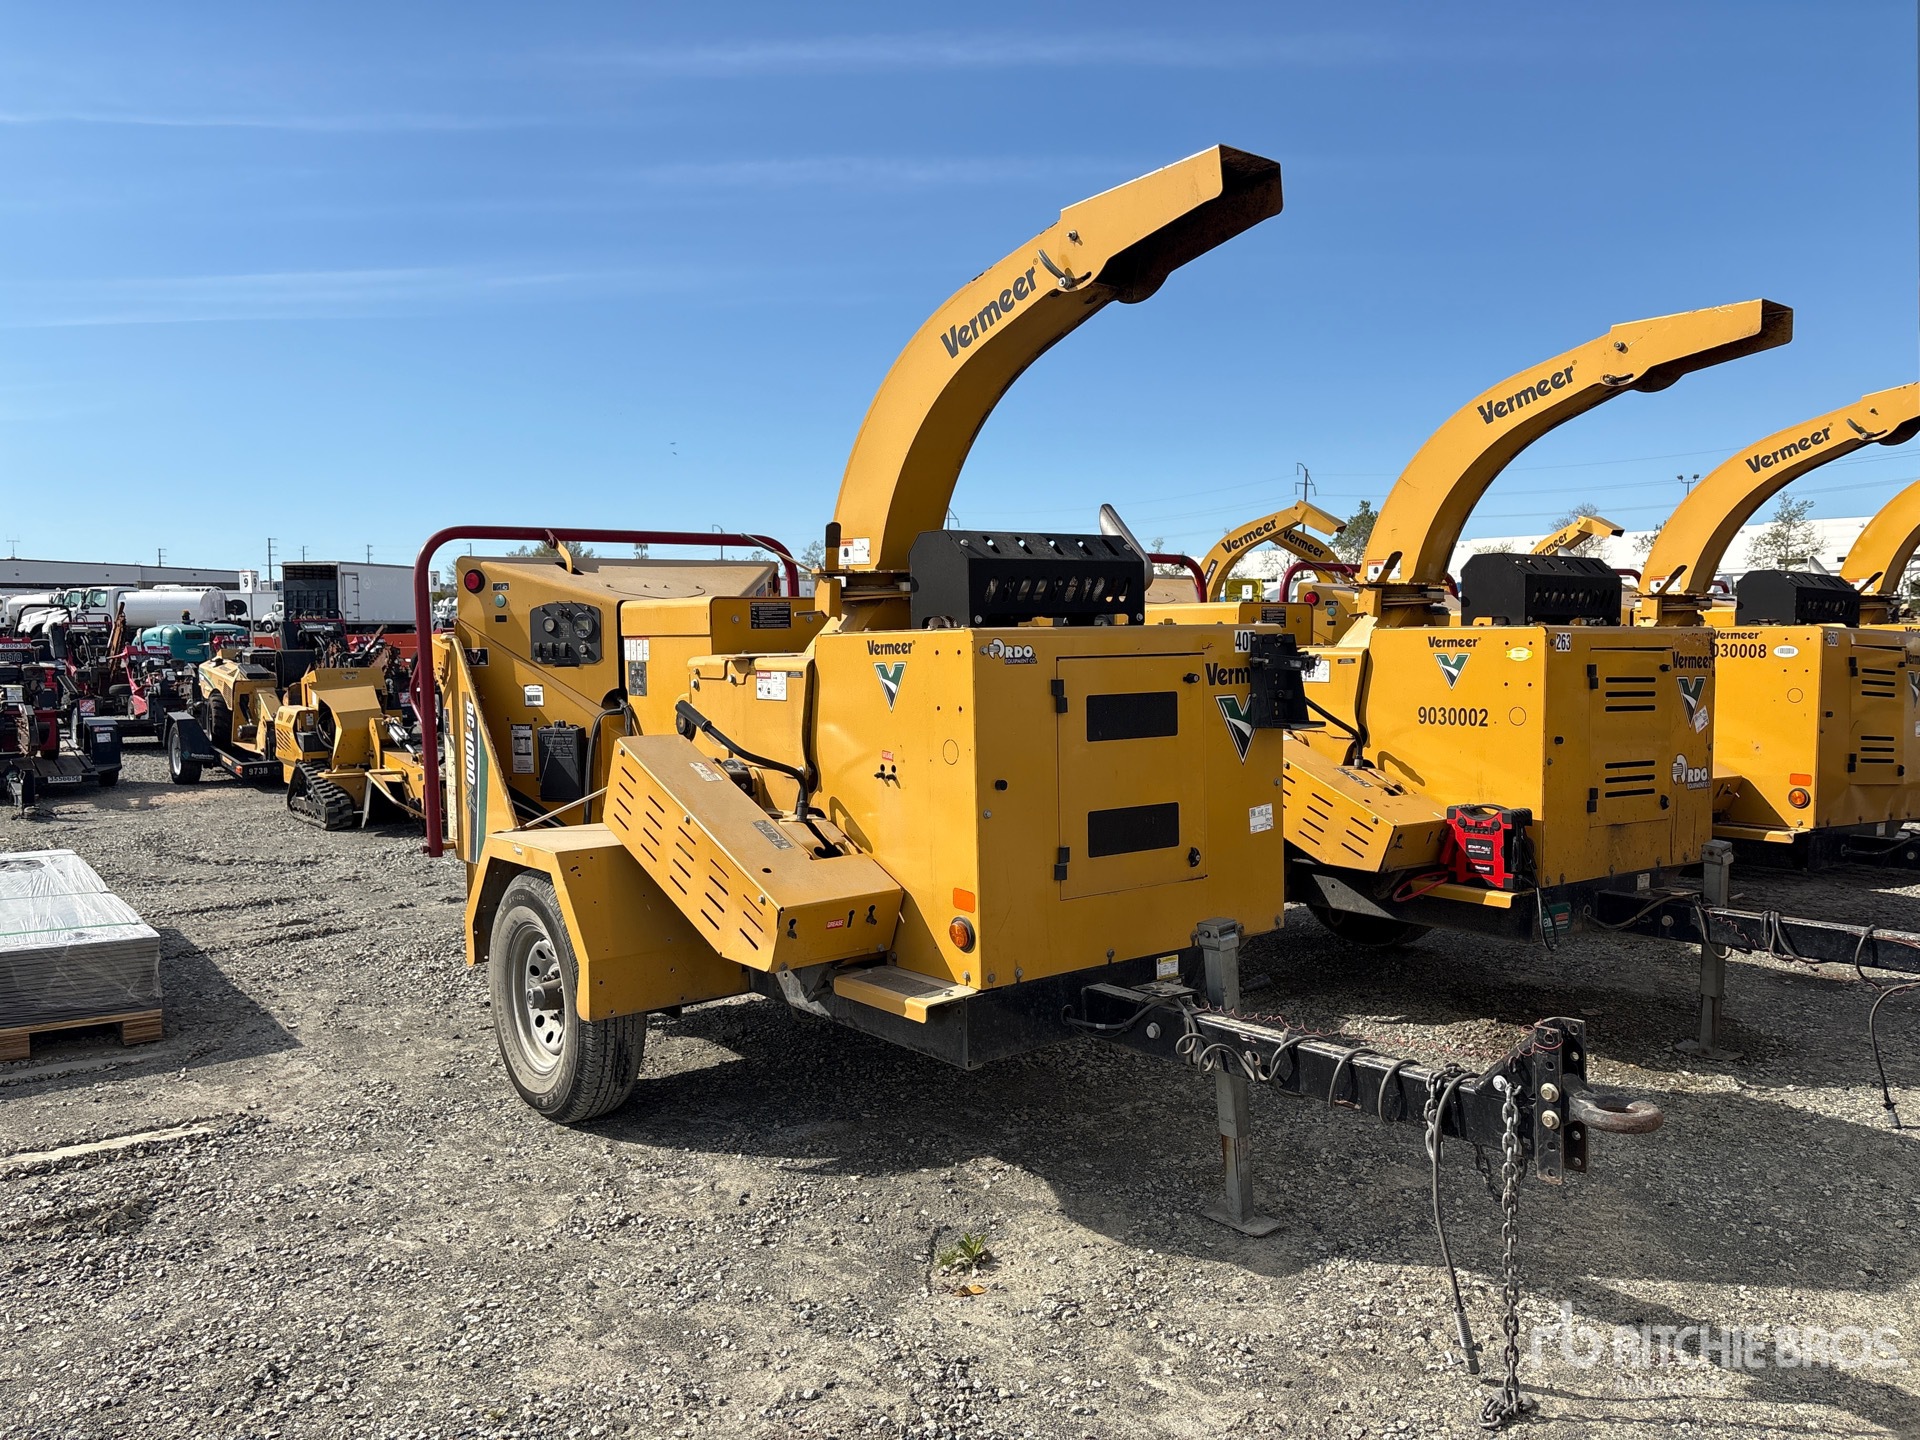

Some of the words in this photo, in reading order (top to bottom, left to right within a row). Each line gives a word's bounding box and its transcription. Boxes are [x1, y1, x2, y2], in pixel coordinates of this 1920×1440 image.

[940, 266, 1037, 359] Vermeer
[1477, 365, 1574, 425] Vermeer
[1745, 427, 1831, 474] Vermeer
[1221, 519, 1277, 554] Vermeer
[1283, 529, 1325, 558] Vermeer
[1534, 532, 1568, 556] ermeer
[867, 640, 913, 655] Vermeer
[1235, 631, 1256, 651] 40
[1428, 636, 1479, 648] Vermeer
[1556, 634, 1571, 651] 263
[1205, 662, 1250, 686] Verm
[1418, 706, 1489, 727] 9030002
[248, 768, 268, 776] 9738
